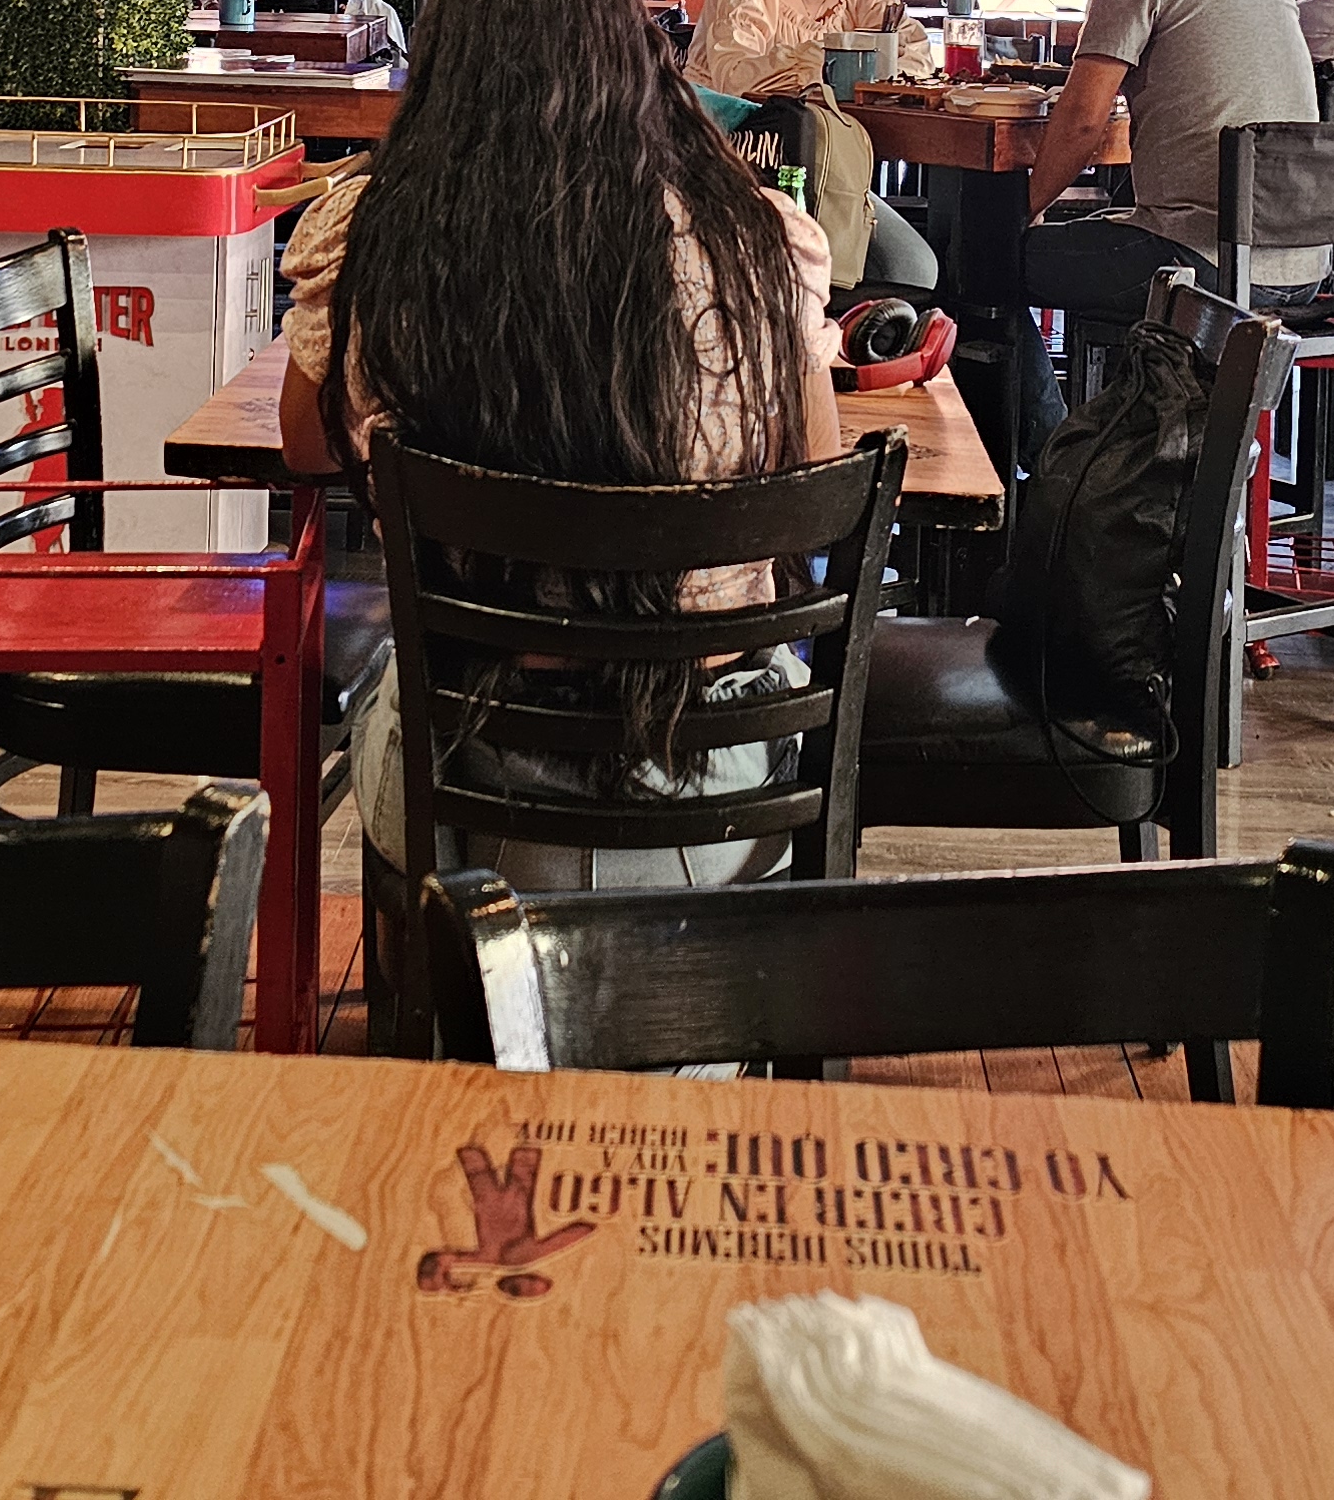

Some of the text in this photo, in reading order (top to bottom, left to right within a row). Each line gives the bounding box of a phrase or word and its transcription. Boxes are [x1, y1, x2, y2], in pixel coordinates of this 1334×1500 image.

[515, 1118, 689, 1148] BEBER HOY
[628, 1146, 688, 1173] VOY
[854, 1136, 1023, 1194] CREO
[1045, 1148, 1134, 1202] YO
[547, 1170, 1009, 1241] CREER EN ALGO
[638, 1224, 984, 1280] TODOS DEBEMOS
